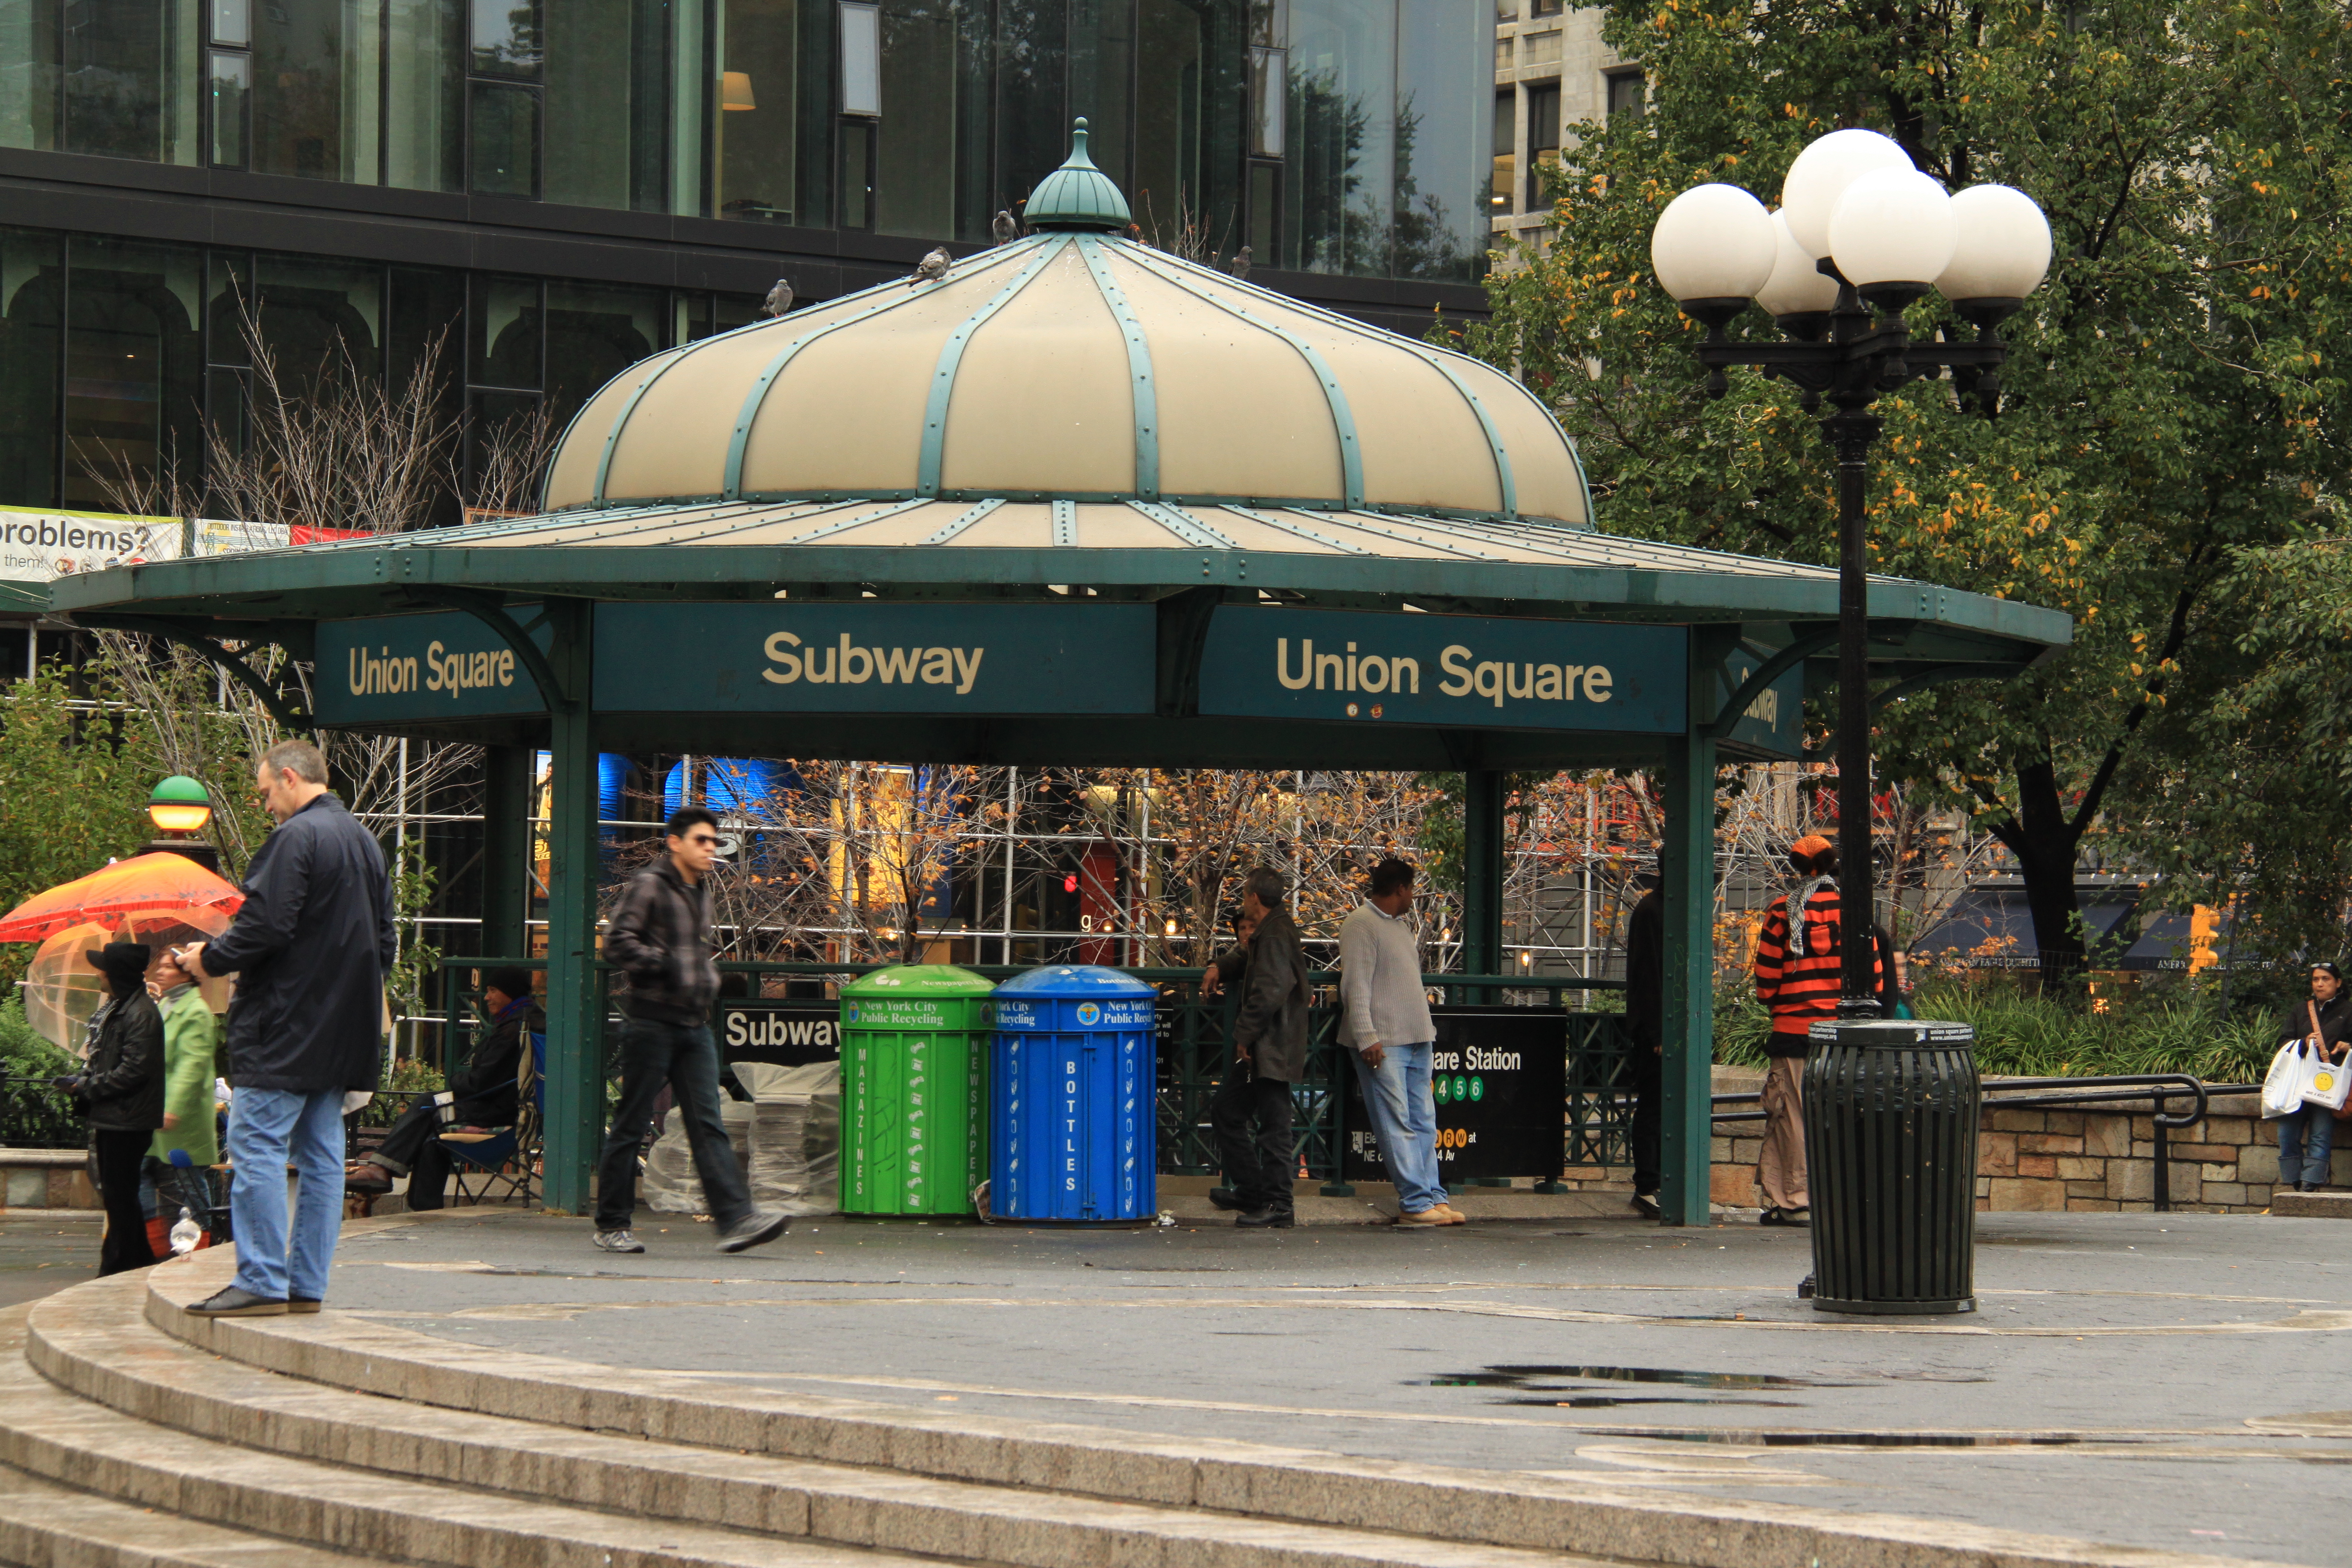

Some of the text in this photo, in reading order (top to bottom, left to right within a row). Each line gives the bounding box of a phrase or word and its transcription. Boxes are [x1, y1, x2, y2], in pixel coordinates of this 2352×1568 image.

[207, 523, 230, 531] OUTDOOR
[0, 519, 151, 552] roblems?
[349, 640, 514, 698] Union Square
[761, 631, 984, 694] Subway
[1277, 637, 1613, 708] Union Square
[865, 1000, 938, 1014] New York City
[1012, 1001, 1029, 1015] City
[1108, 1001, 1128, 1011] New
[1130, 1000, 1145, 1011] York
[861, 1012, 944, 1027] Public Recycling
[1000, 1013, 1035, 1027] Recycling
[1104, 1013, 1132, 1024] Public
[1466, 1045, 1521, 1071] Station
[1438, 1080, 1447, 1097] 4
[1456, 1081, 1464, 1095] 5
[1472, 1081, 1479, 1096] 6
[856, 1048, 867, 1195] MAGAZINES
[969, 1040, 979, 1204] NEWSPAPERS
[1066, 1061, 1076, 1191] BOTTLES
[1446, 1132, 1452, 1143] R
[1458, 1132, 1465, 1143] W
[1468, 1132, 1476, 1143] at
[1364, 1150, 1375, 1162] NE
[1445, 1149, 1455, 1161] Av
